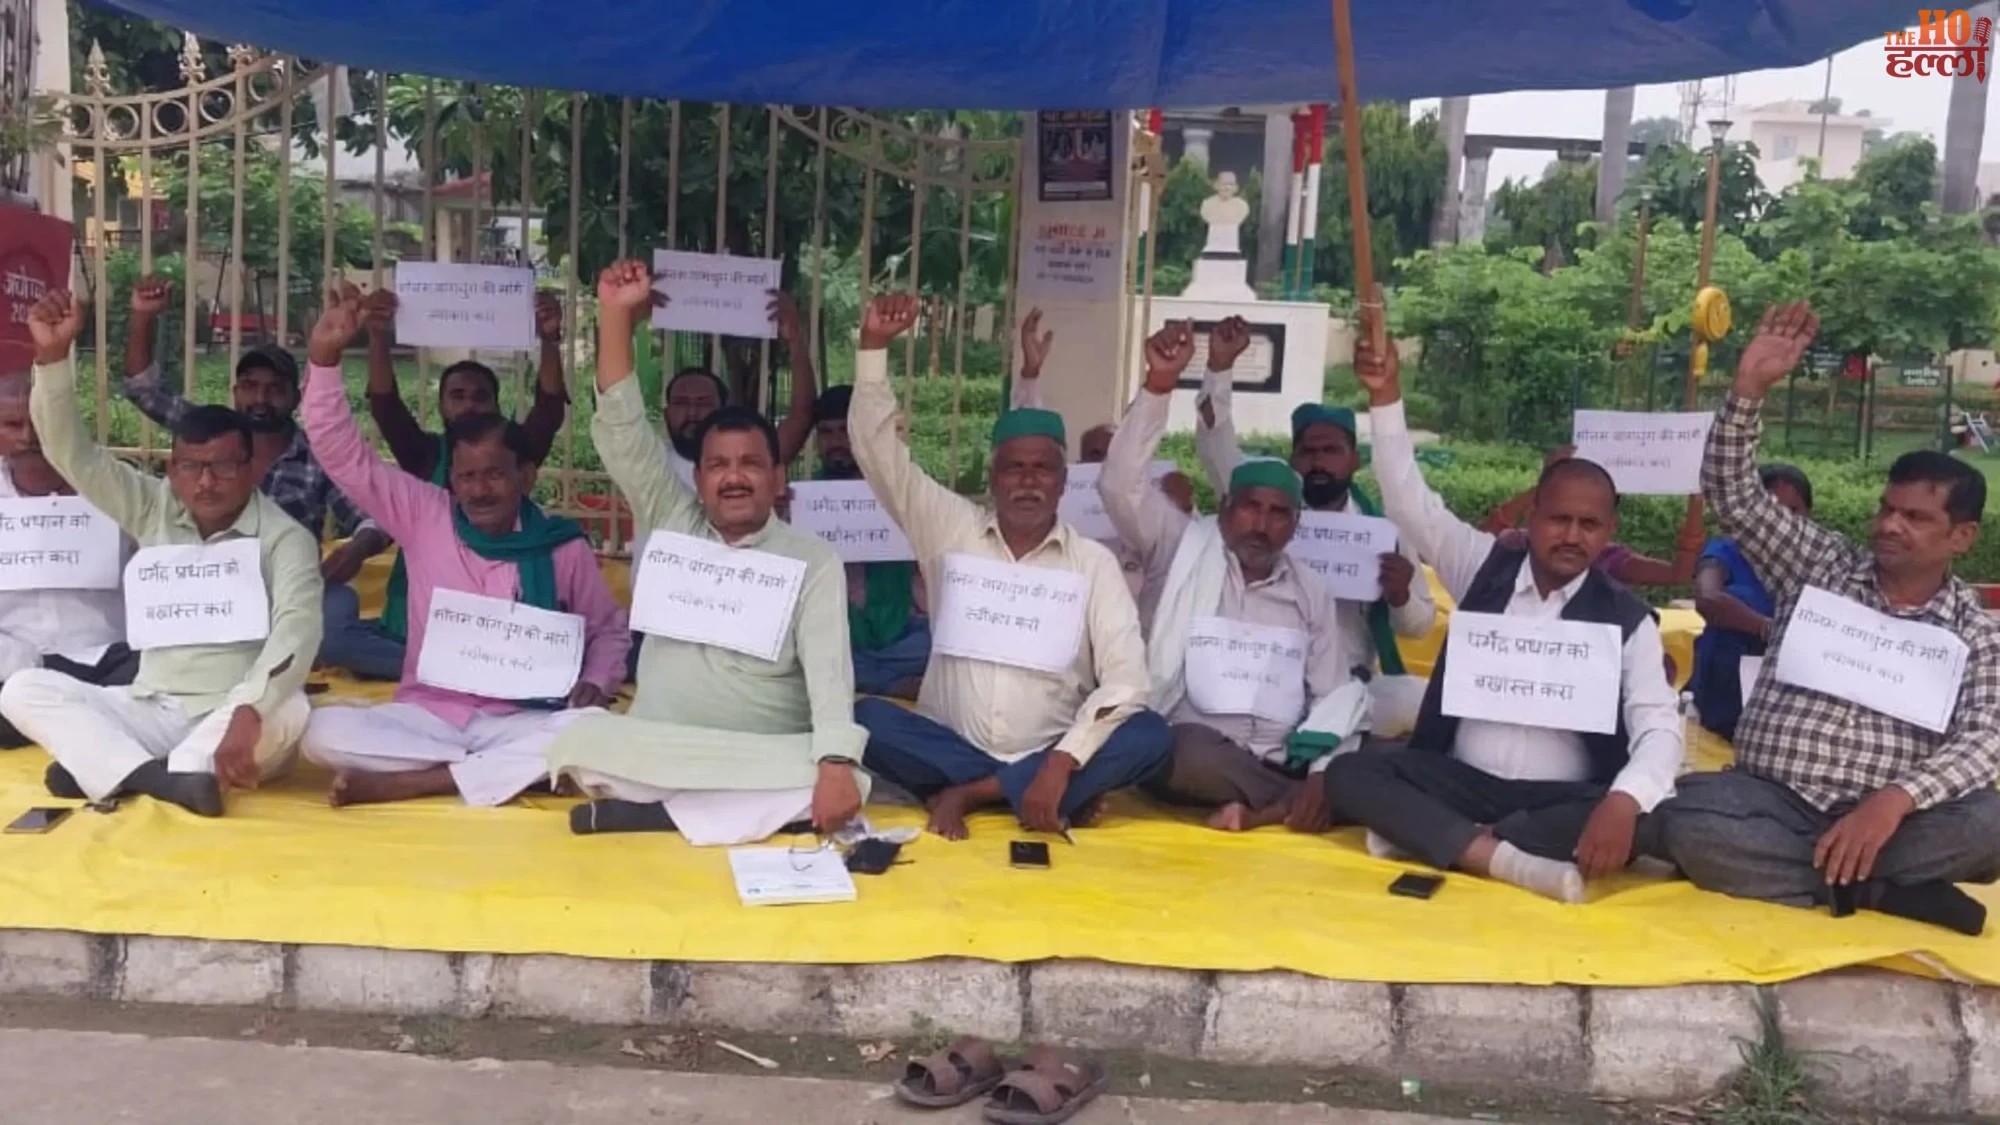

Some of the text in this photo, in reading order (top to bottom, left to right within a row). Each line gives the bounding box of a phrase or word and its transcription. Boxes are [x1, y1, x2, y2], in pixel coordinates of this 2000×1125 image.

[524, 624, 542, 642] की
[1515, 638, 1563, 658] प्रधान
[1567, 642, 1593, 661] को
[1896, 639, 1916, 658] की
